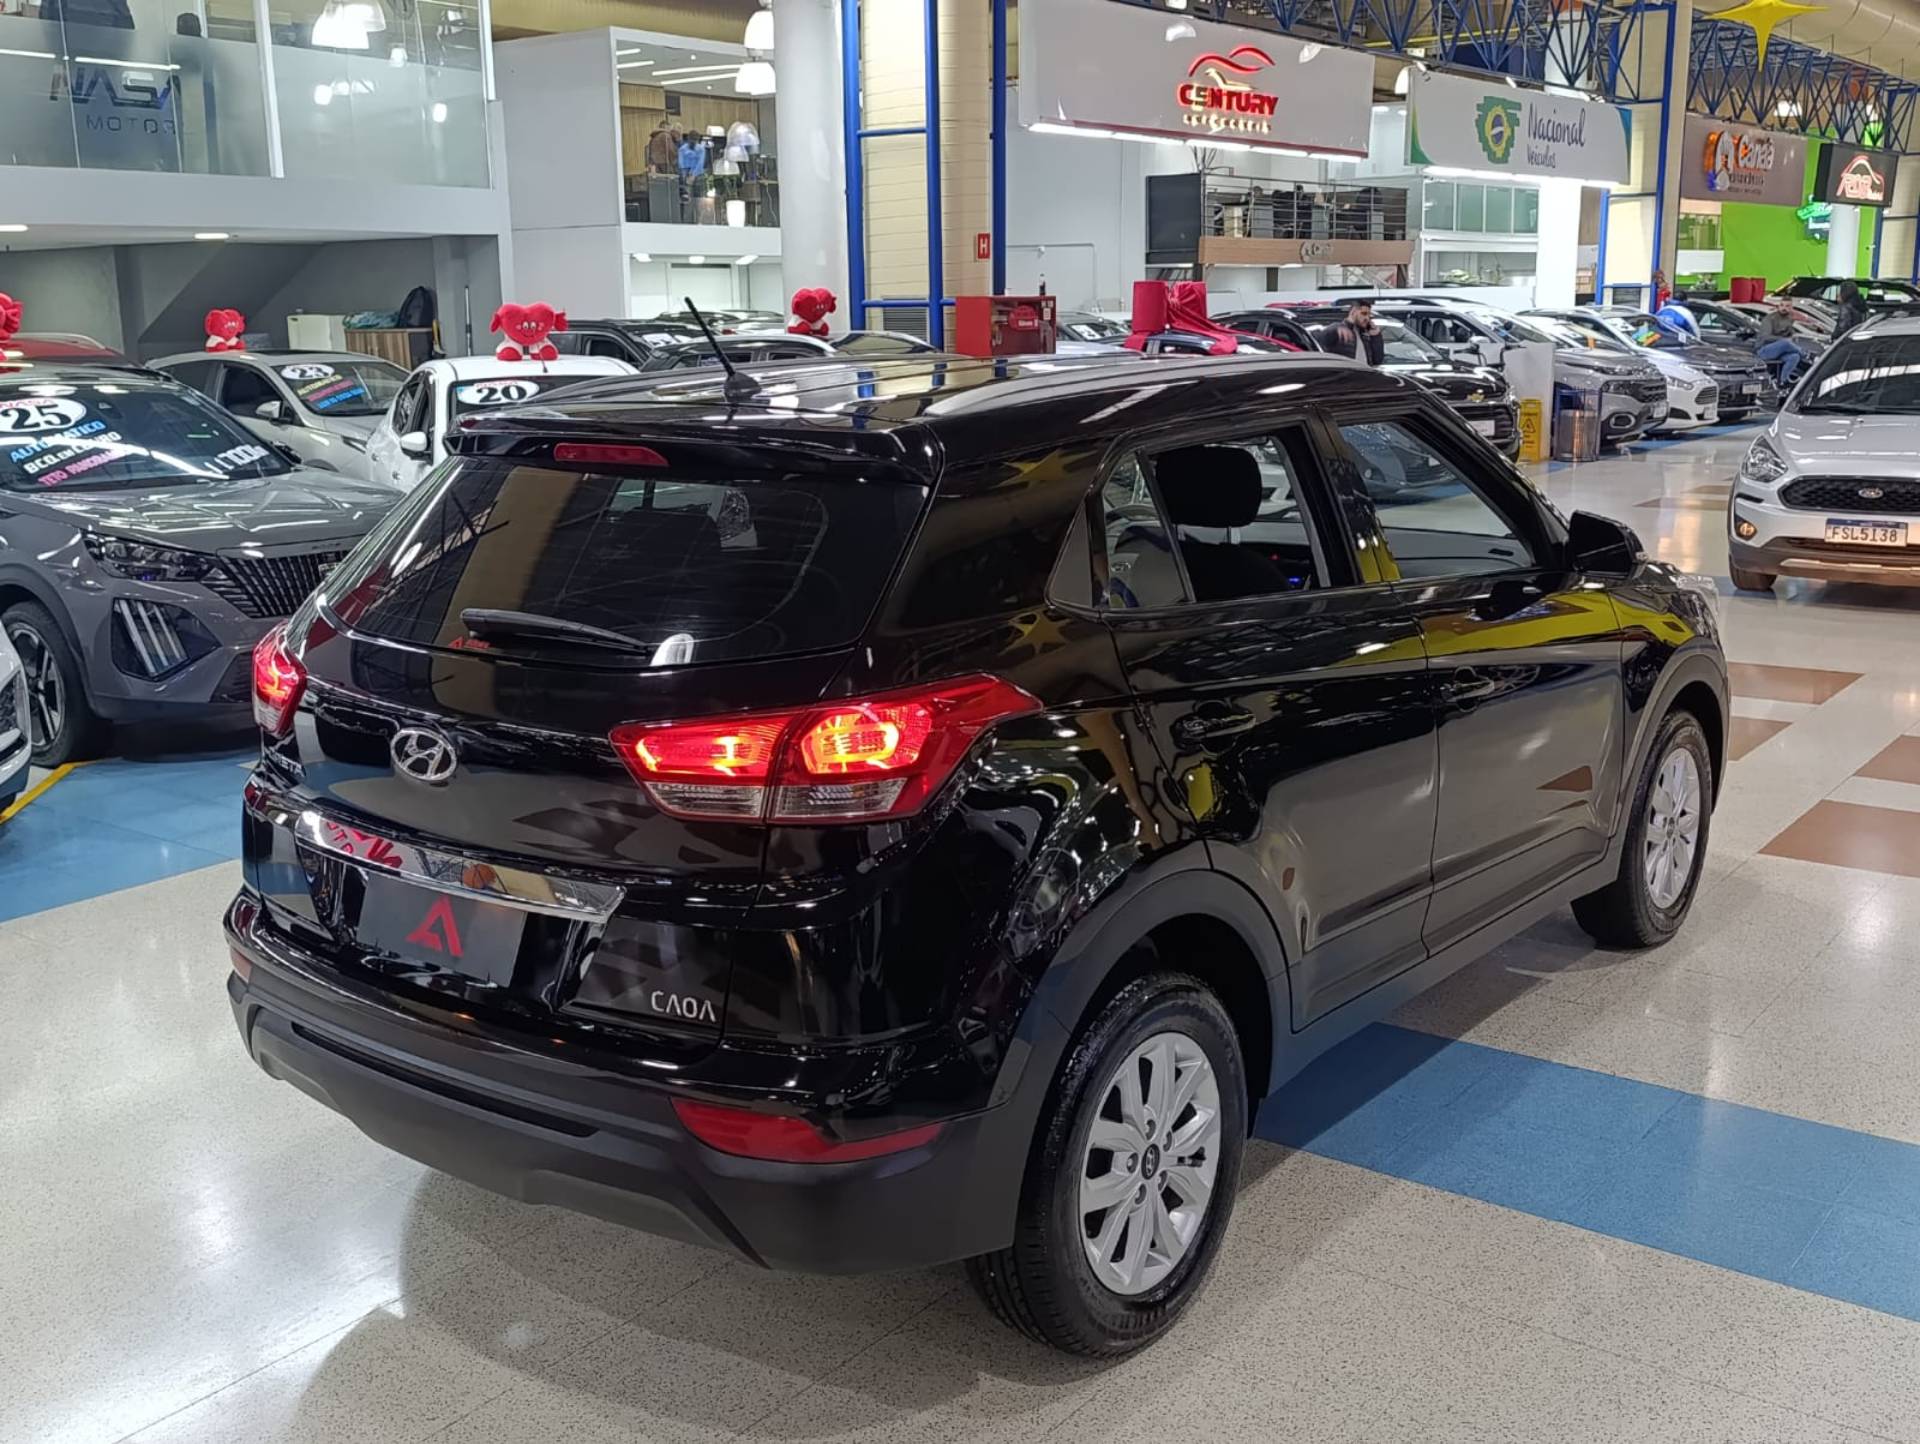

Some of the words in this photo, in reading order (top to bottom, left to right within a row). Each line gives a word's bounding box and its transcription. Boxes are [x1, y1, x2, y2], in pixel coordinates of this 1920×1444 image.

[1178, 83, 1279, 116] CENTURY
[1528, 102, 1586, 147] Nacional
[980, 238, 988, 255] H
[476, 385, 527, 403] 20
[0, 404, 72, 430] 25
[10, 420, 106, 463] AUTOATICO
[651, 990, 717, 1022] CAOA
